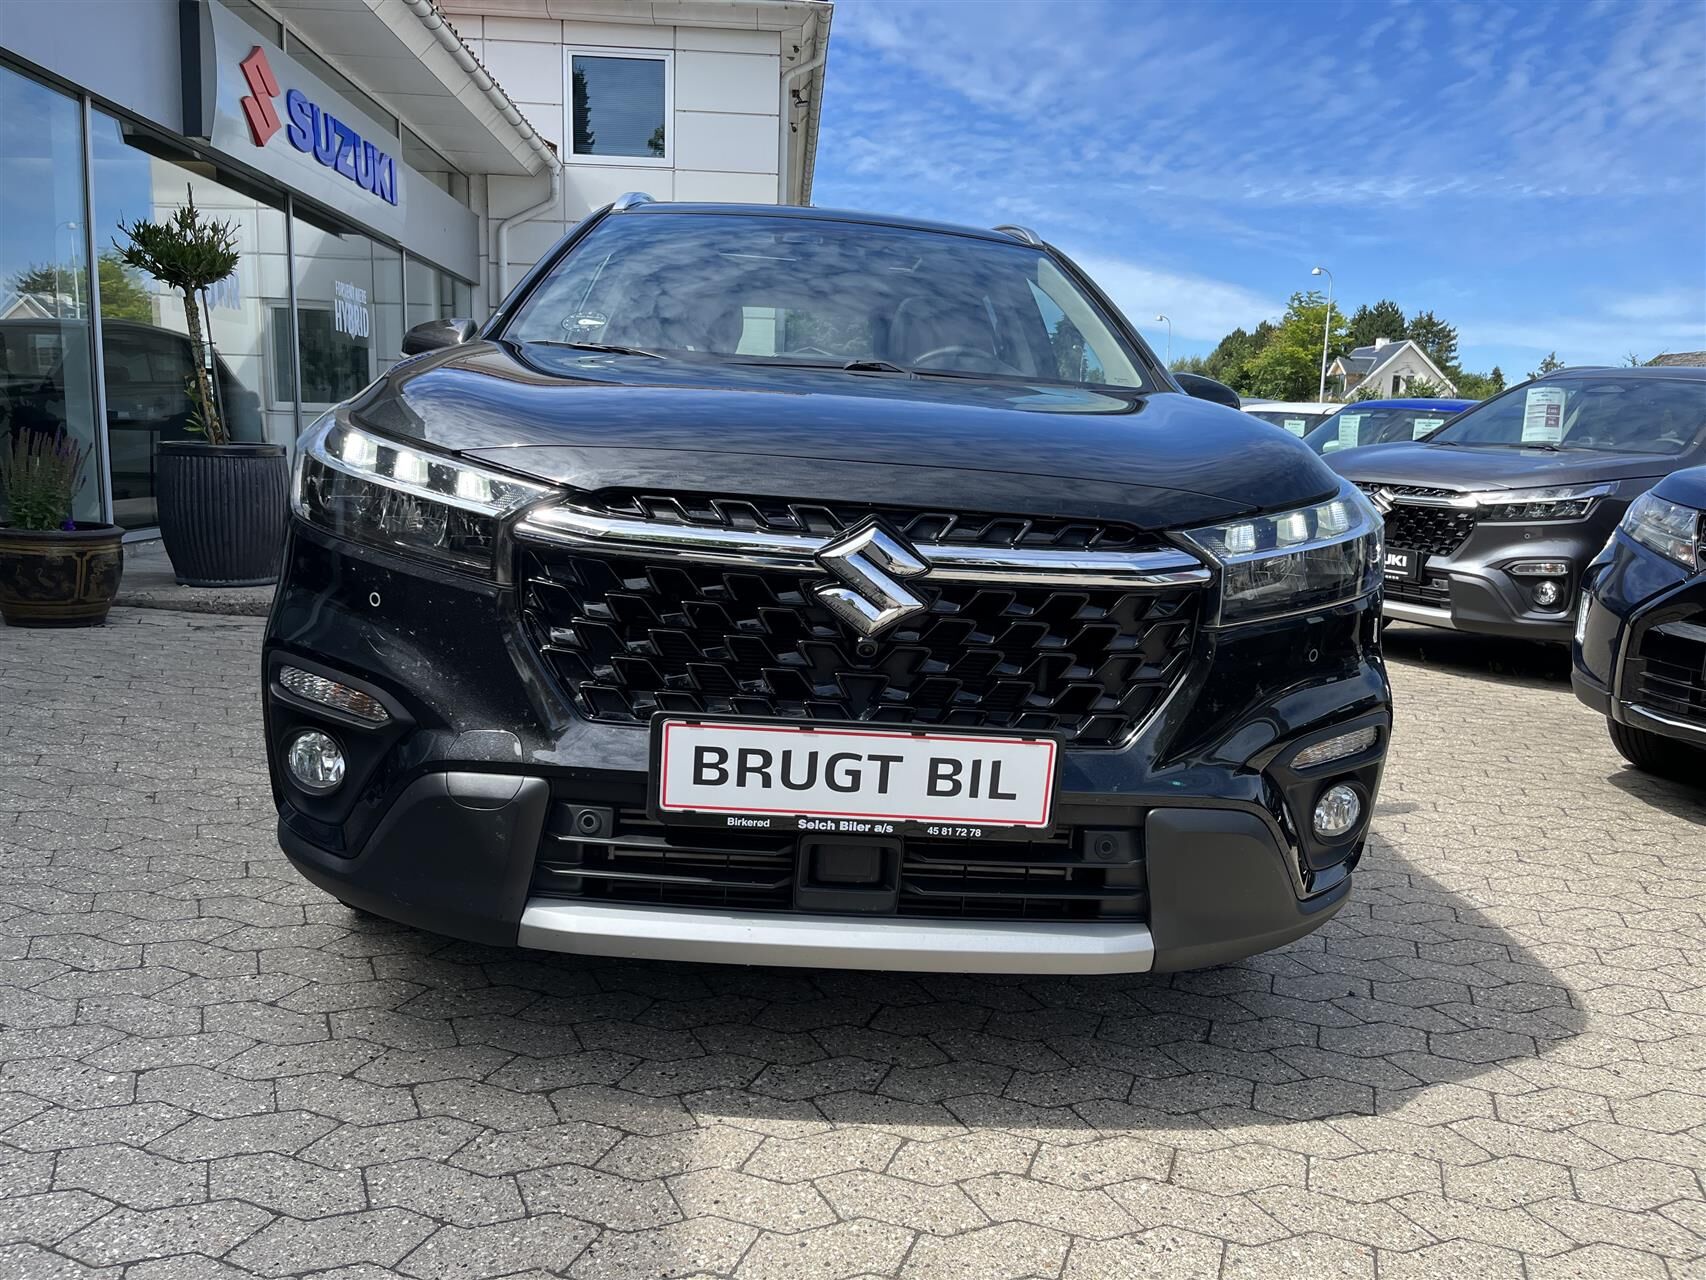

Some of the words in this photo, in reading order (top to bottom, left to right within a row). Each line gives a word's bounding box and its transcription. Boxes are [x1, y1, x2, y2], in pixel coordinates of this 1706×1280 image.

[286, 88, 399, 206] SUZUKI
[335, 299, 369, 338] HYBRID
[1385, 553, 1408, 567] UKI
[692, 745, 904, 794] BRUGT
[926, 757, 1017, 801] BIL
[727, 817, 770, 828] Birkerød
[798, 819, 836, 831] Selch
[839, 821, 872, 832] Biler
[874, 823, 894, 834] a/s
[927, 826, 940, 836] 45
[941, 827, 953, 836] 81
[955, 827, 967, 837] 72
[969, 828, 982, 838] 78
